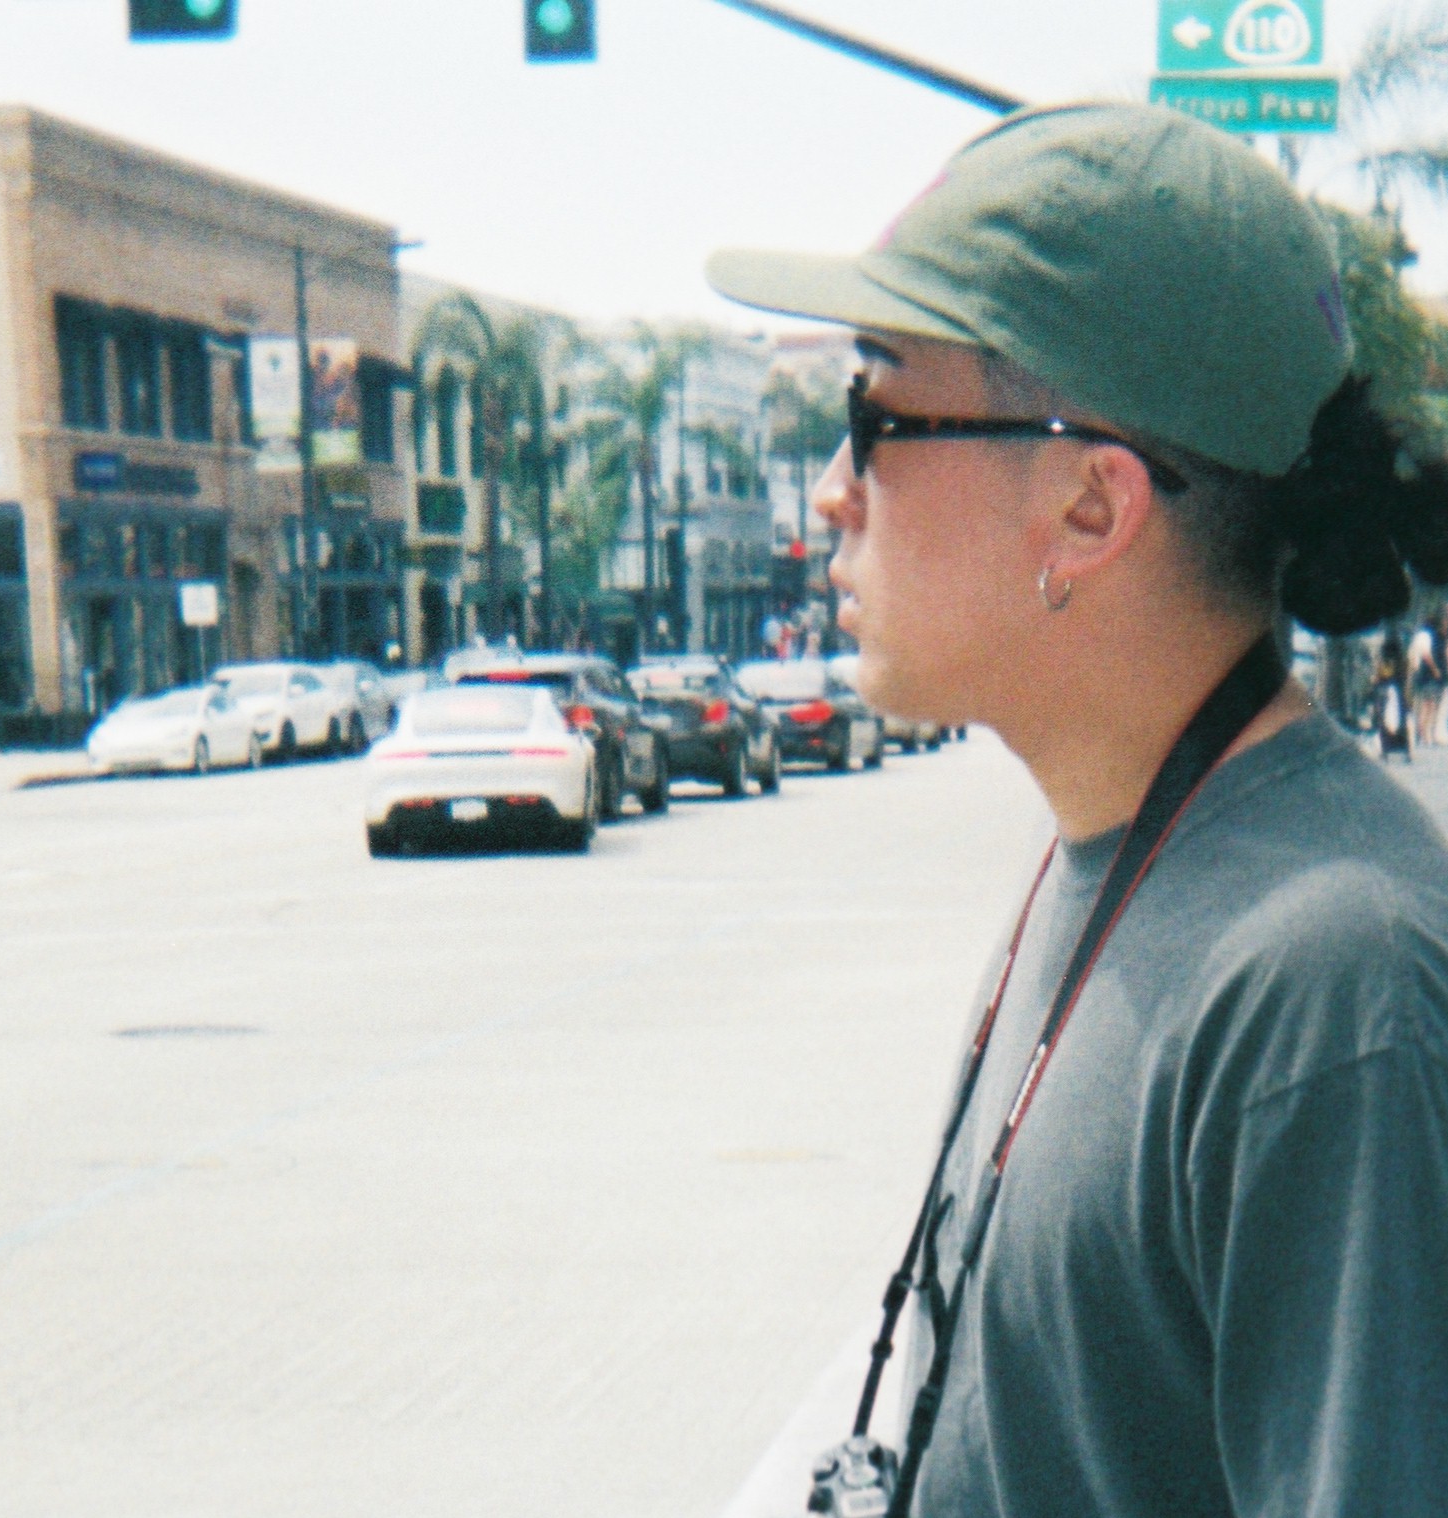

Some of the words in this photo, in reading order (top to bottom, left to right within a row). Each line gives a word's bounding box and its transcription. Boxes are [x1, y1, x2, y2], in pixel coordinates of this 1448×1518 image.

[1244, 15, 1295, 50] 110
[1155, 91, 1248, 122] Arroyo
[1259, 91, 1334, 122] Pkwy
